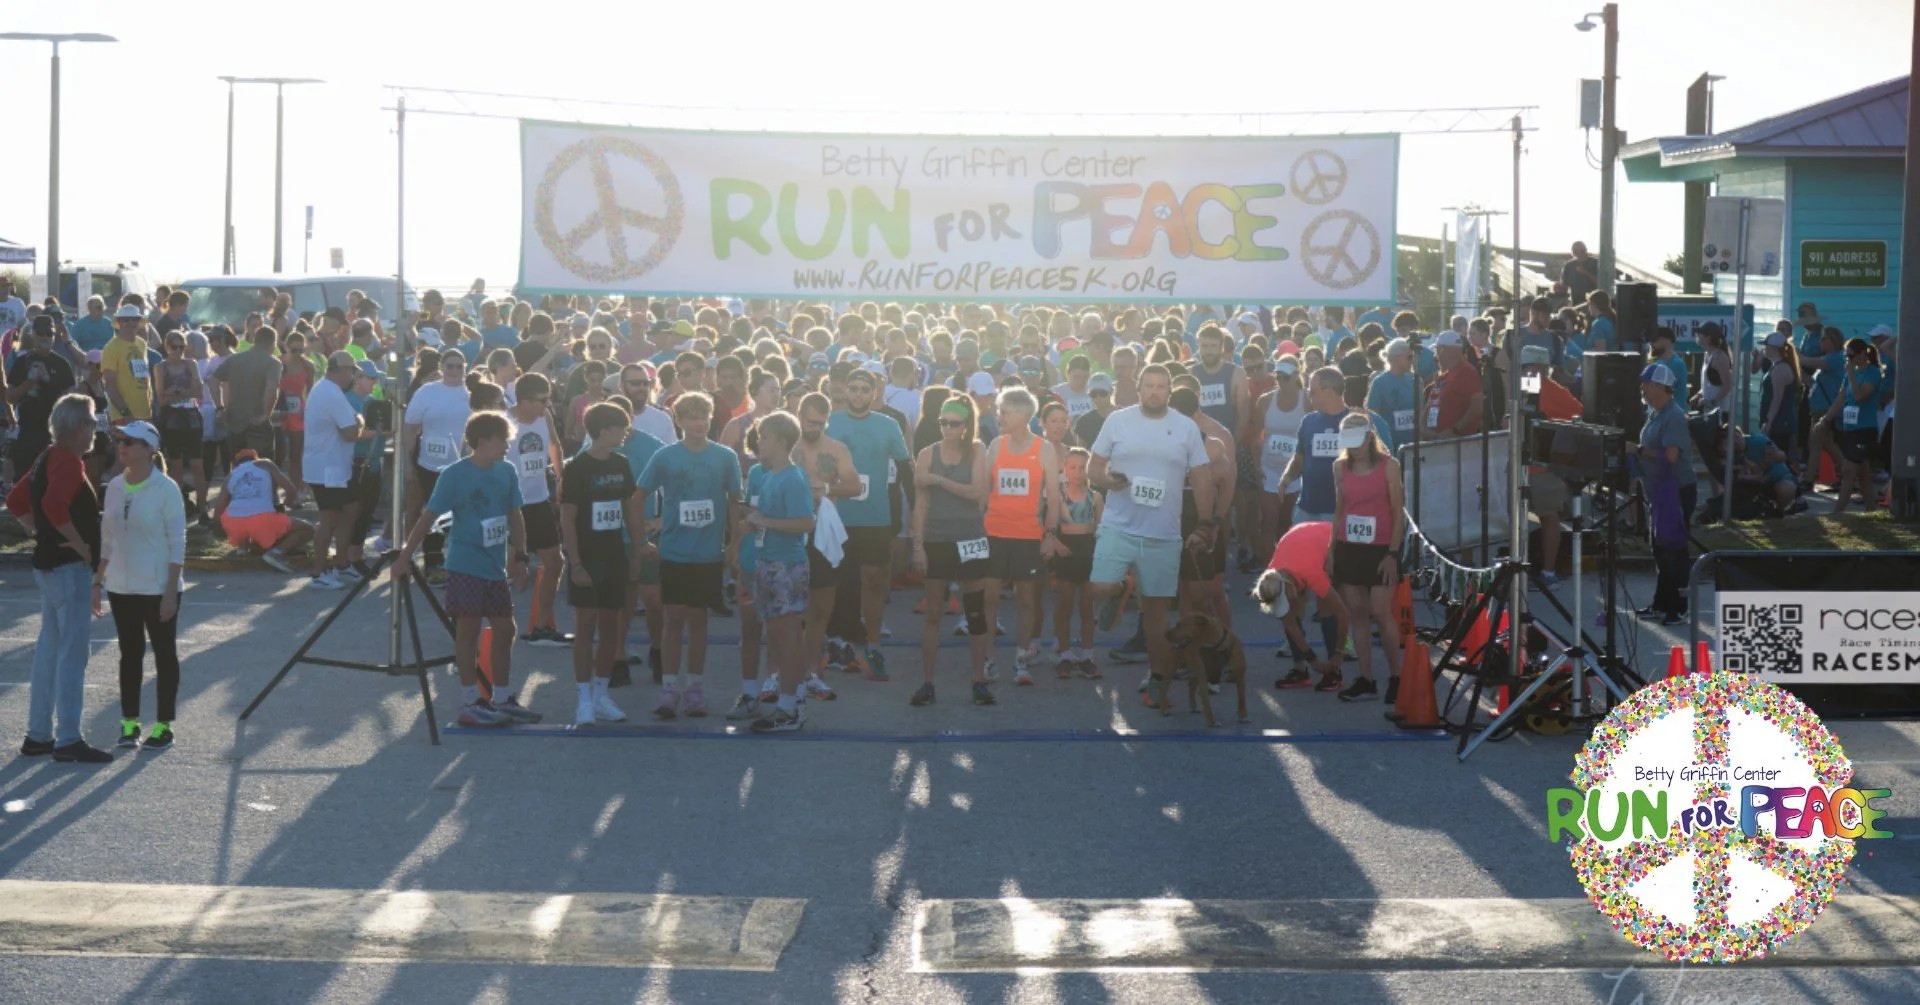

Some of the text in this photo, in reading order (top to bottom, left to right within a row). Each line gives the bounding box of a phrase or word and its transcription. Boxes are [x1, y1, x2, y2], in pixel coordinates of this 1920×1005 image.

[821, 145, 1146, 190] Betty Griffin Center
[709, 178, 1290, 261] RUN FOR PEACE
[1809, 251, 1878, 263] 911 ADDRESS
[1001, 477, 1026, 488] 1444
[1135, 485, 1163, 500] 1562
[684, 508, 711, 522] 1156
[1347, 523, 1372, 536] 1429
[1820, 608, 1920, 631] race
[1839, 637, 1871, 647] Race
